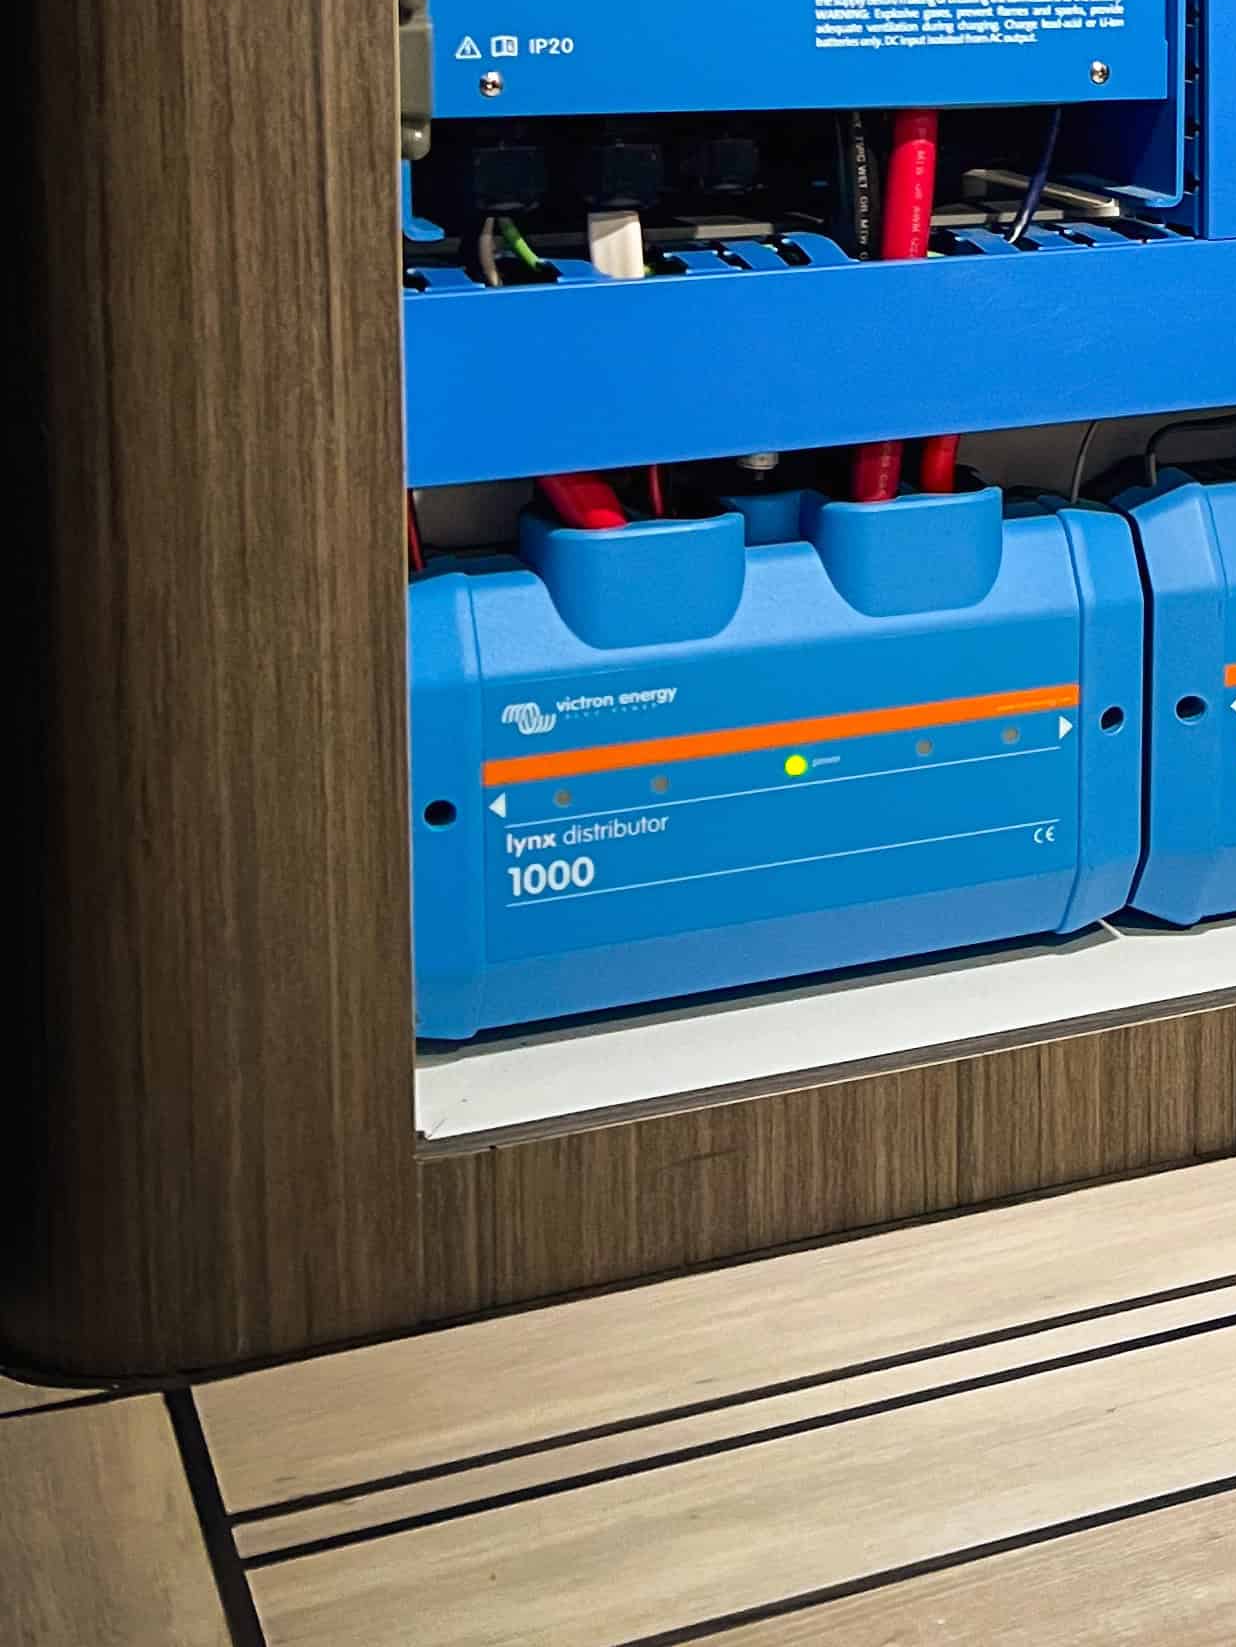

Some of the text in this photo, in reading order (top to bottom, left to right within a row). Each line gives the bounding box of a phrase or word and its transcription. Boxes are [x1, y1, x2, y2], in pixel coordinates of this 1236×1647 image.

[529, 38, 574, 54] IP20
[556, 695, 614, 712] victron
[619, 688, 678, 704] energy
[506, 816, 669, 857] lynx distributor
[507, 856, 594, 896] 1000
